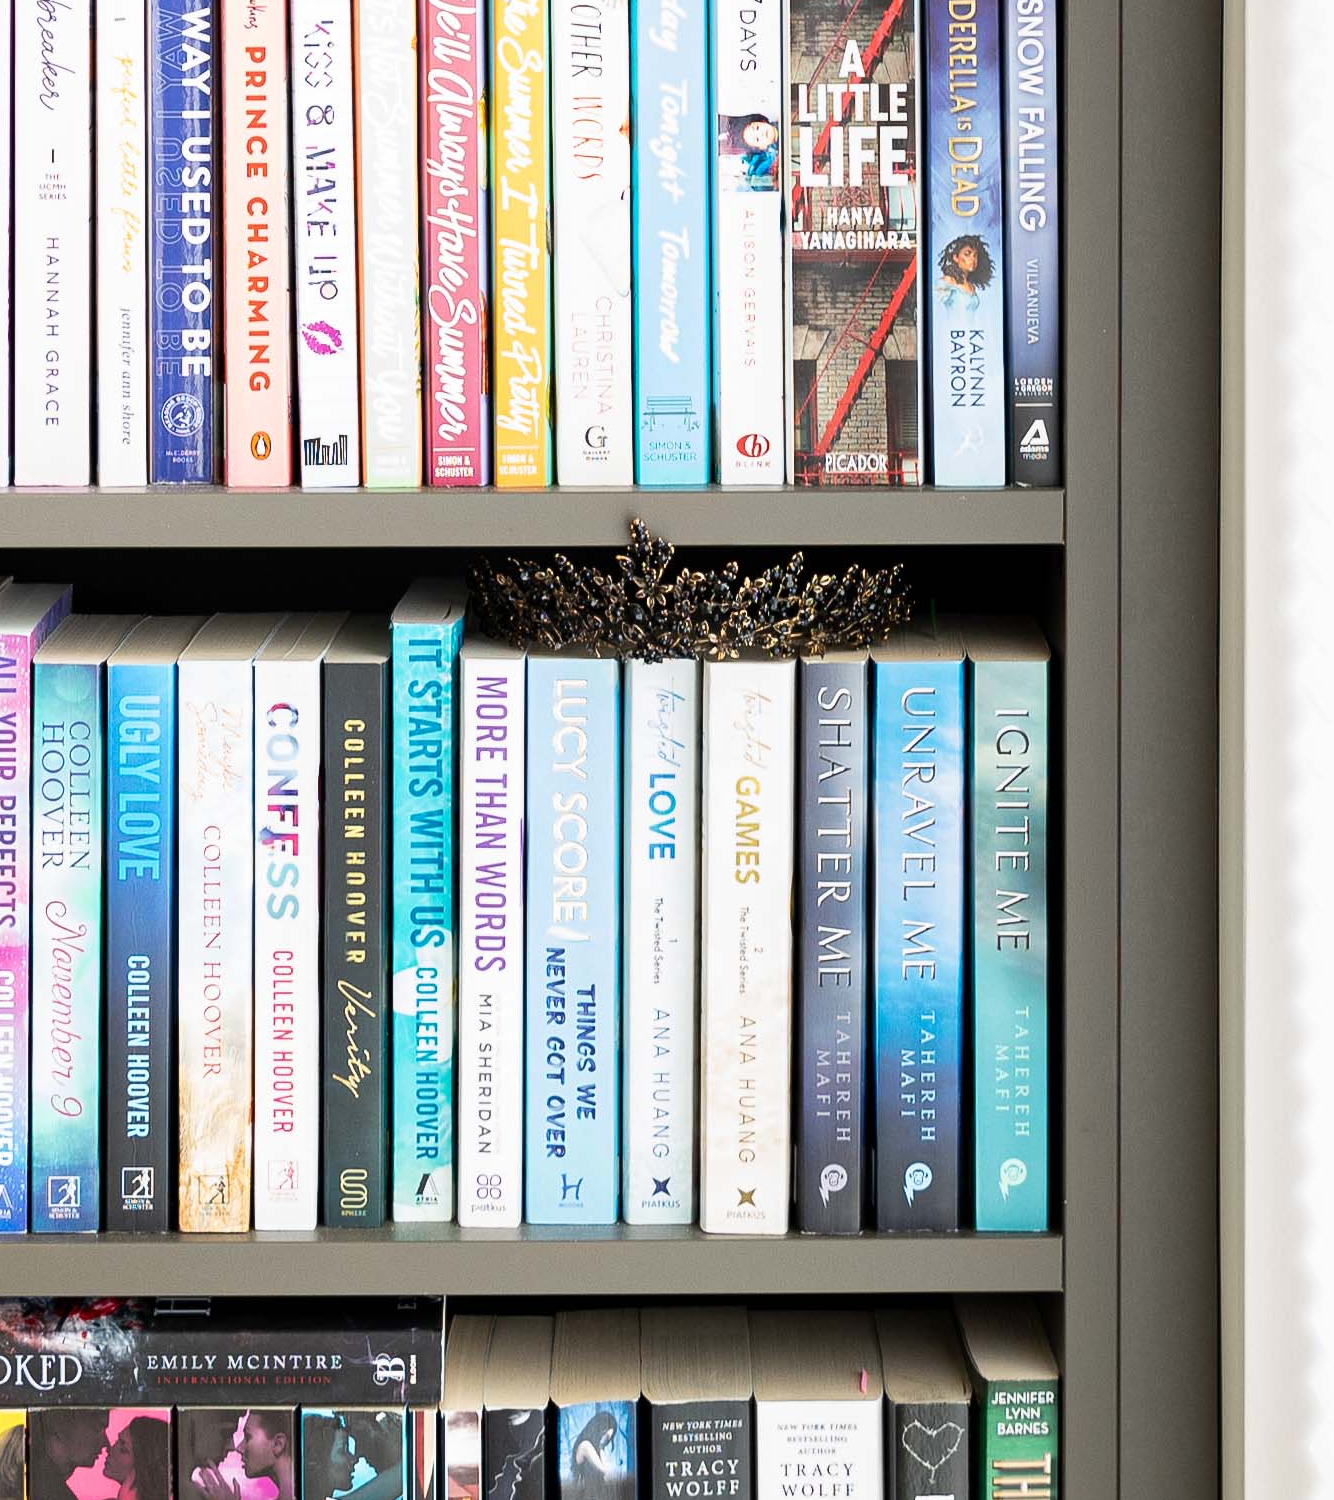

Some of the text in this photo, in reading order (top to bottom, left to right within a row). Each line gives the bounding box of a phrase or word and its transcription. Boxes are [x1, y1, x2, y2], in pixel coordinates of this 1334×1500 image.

[798, 83, 908, 122] LITTLE
[838, 40, 866, 78] A
[799, 126, 909, 187] LIFE
[1017, 108, 1046, 232] FALLING
[245, 47, 272, 392] PRINCE CHARMING
[45, 237, 60, 427] HANNAH GRACE
[951, 330, 967, 407] BAYRON
[968, 330, 985, 407] KALYNN
[118, 694, 161, 880] UGLY LOVE
[408, 638, 445, 947] IT STARTS WITH US
[475, 677, 507, 972] MORE THAN WORDS
[333, 980, 375, 1097] Verity
